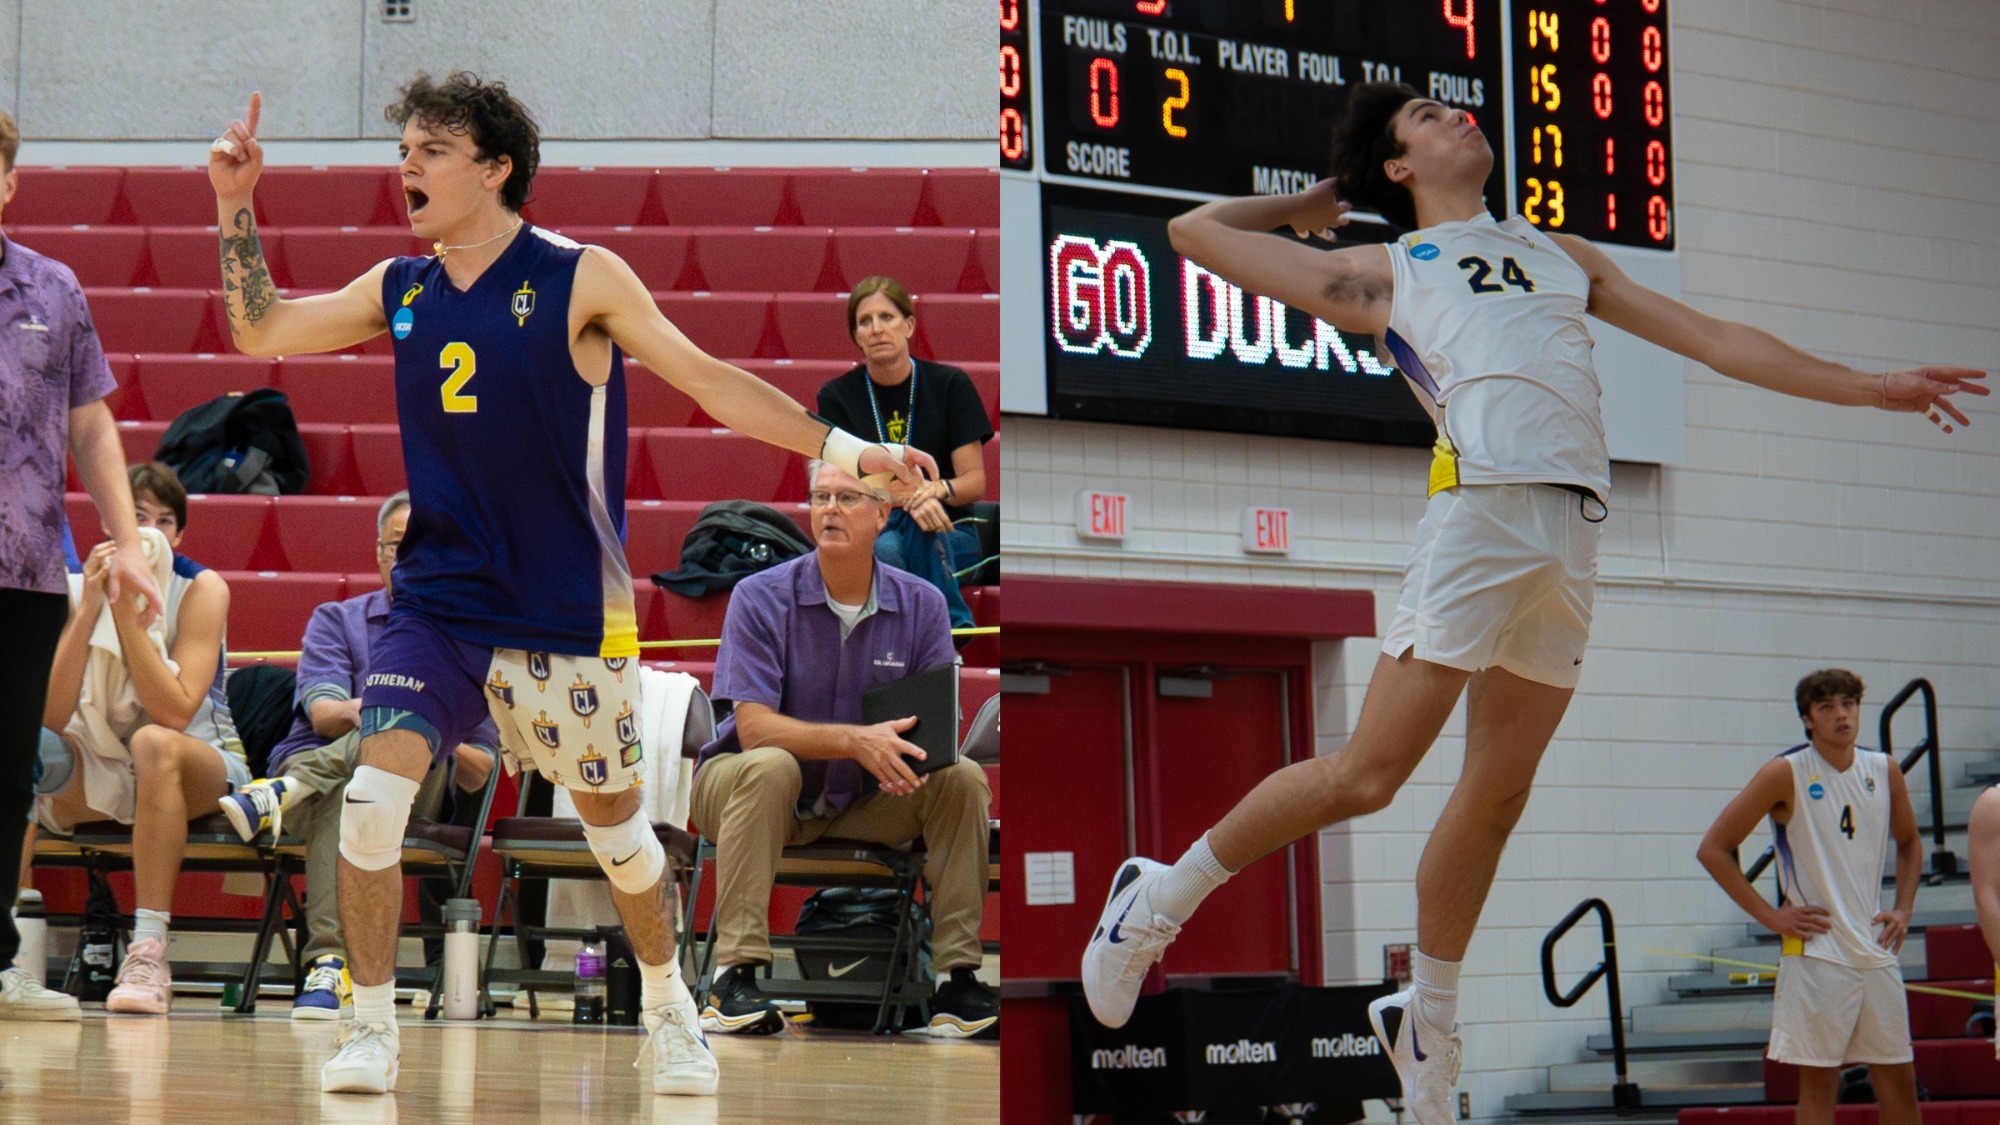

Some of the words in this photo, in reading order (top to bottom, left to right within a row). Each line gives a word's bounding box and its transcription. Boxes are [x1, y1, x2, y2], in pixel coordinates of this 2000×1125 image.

[1064, 16, 1127, 54] FOULS
[1148, 29, 1200, 64] T.O.L.
[1529, 9, 1559, 51] 14
[1592, 17, 1610, 64] 0
[1643, 26, 1661, 72] 0
[1000, 45, 1020, 97] 0
[1219, 39, 1289, 78] PLAYER
[1298, 52, 1346, 85] FOUL
[1090, 57, 1119, 129] 0
[1163, 68, 1189, 139] 2
[1428, 71, 1484, 107] FOULS
[1531, 64, 1560, 111] 15
[1593, 72, 1612, 119] 0
[1644, 80, 1663, 127] 0
[1001, 108, 1022, 160] 0
[1067, 141, 1130, 178] SCORE
[1533, 124, 1562, 168] 17
[1606, 137, 1614, 175] 1
[1647, 140, 1665, 186] 0
[1252, 165, 1317, 196] MATCH
[1525, 177, 1564, 228] 23
[1608, 193, 1616, 230] 1
[1648, 195, 1667, 241] 0
[1457, 255, 1536, 294] 24
[1052, 233, 1152, 358] GO
[1180, 255, 1394, 376] DUCK
[440, 342, 477, 412] 2
[1091, 494, 1127, 535] EXIT
[1256, 509, 1289, 550] EXIT
[363, 673, 425, 692] UTHERAN
[573, 690, 595, 715] CL
[582, 761, 604, 785] CL
[1840, 804, 1855, 840] 4
[1091, 1045, 1166, 1069] molten
[1206, 1040, 1276, 1065] molten
[1312, 1034, 1380, 1057] molten
